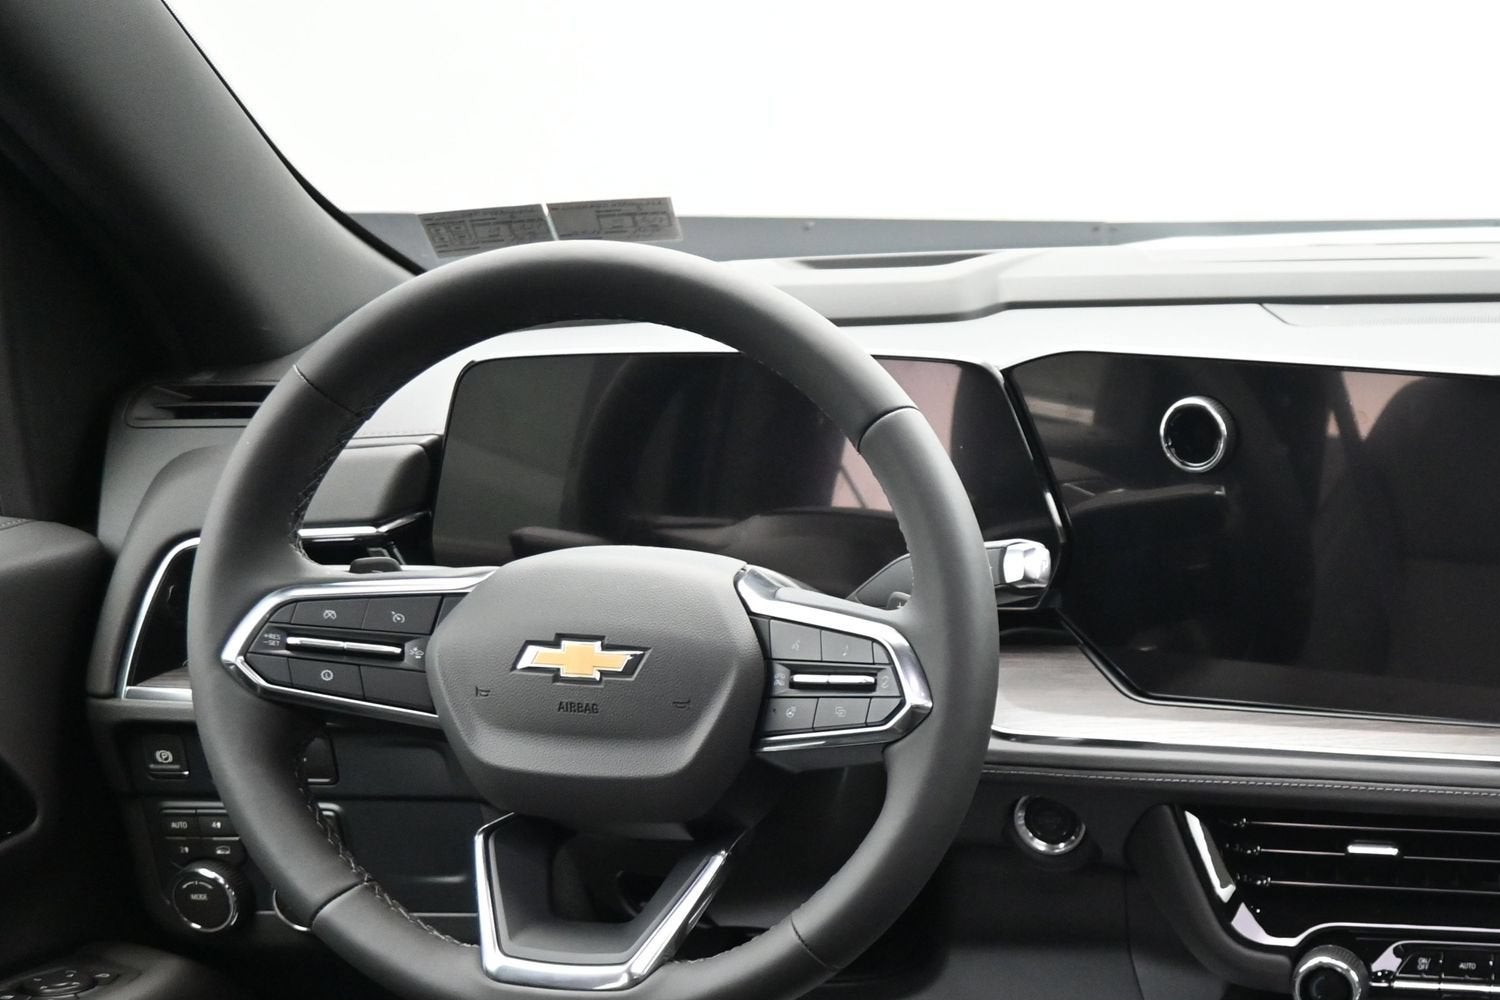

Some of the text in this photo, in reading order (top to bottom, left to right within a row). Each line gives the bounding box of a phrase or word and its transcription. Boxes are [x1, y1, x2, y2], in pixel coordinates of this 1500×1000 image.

[557, 701, 599, 714] AIRBAG
[171, 821, 188, 829] AUTO
[1458, 962, 1477, 970] AUTO
